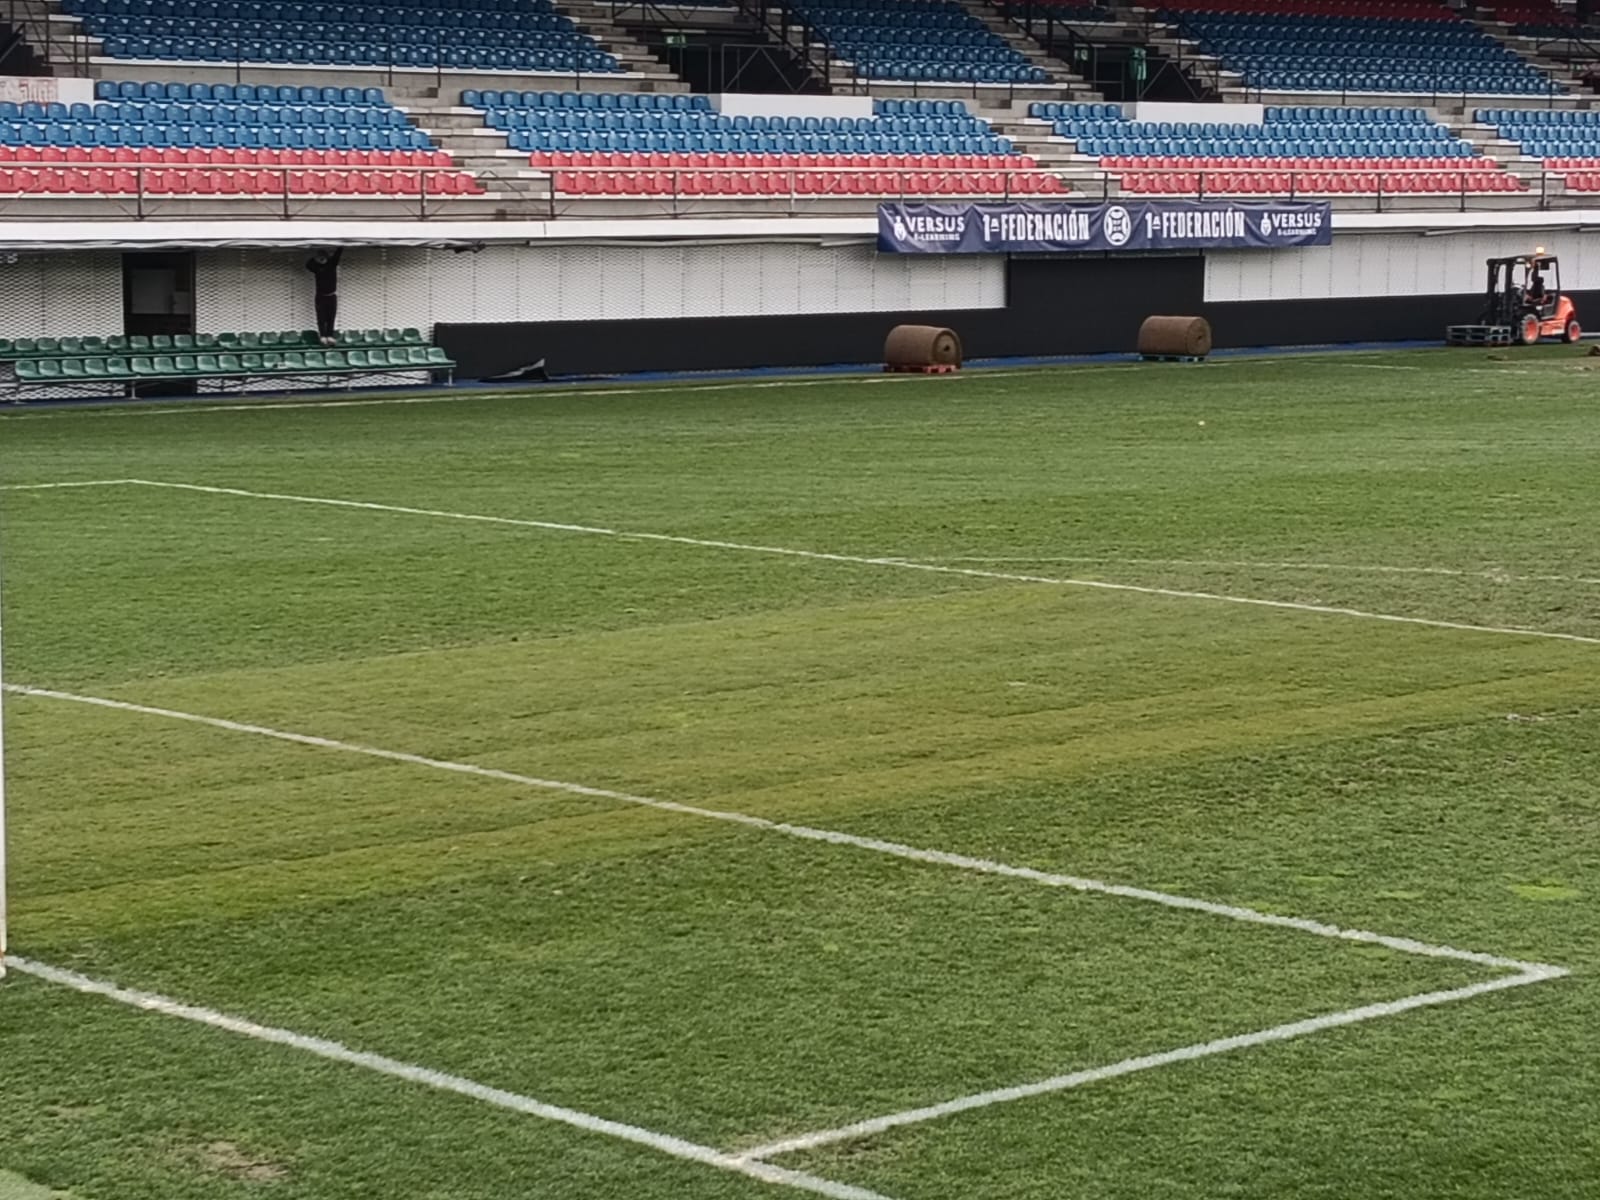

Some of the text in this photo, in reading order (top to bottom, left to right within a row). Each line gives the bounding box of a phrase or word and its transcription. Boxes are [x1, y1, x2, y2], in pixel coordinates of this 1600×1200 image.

[906, 216, 965, 233] VERSUS
[1000, 208, 1090, 241] FEDERACIÓN
[1162, 207, 1245, 239] FEDERACIÓN
[1271, 212, 1322, 228] VERSUS
